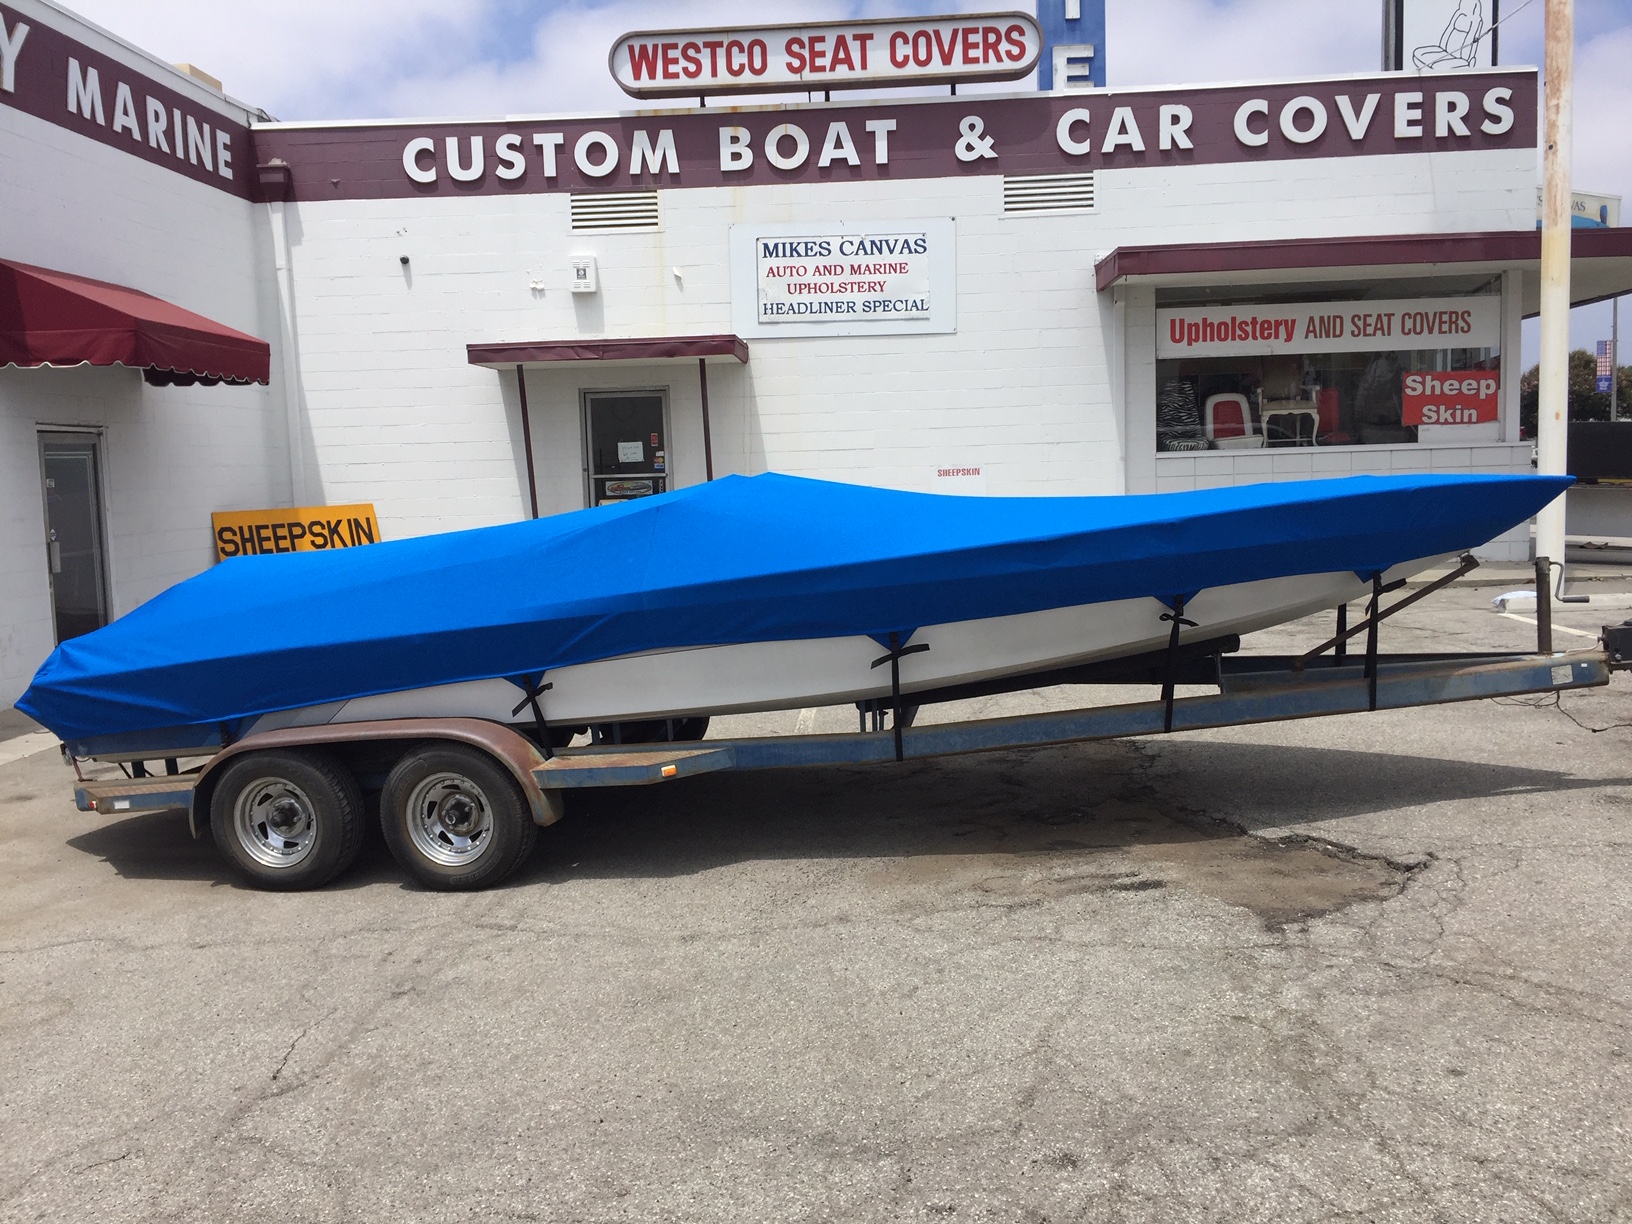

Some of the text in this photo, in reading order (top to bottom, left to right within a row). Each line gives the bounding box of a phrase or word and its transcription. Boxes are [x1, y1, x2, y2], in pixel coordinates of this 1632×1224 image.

[627, 24, 1027, 81] WESTCO SEAT COVERS
[66, 56, 233, 180] MARINE
[402, 87, 1515, 184] CUSTOM BOAT & CAR COVERS
[762, 238, 927, 258] MIKES CANVAS
[766, 262, 909, 278] AUTO AND MARINE
[787, 280, 887, 295] UPHOLSTERY
[763, 299, 930, 315] HEADLINER SPECIAL
[1170, 310, 1472, 347] Upholstery AND SEAT COVERS
[1404, 375, 1496, 399] Sheep
[1421, 405, 1477, 423] Skin
[937, 468, 980, 477] SHEEPSKIN
[217, 517, 374, 557] SHEEPSKIN
